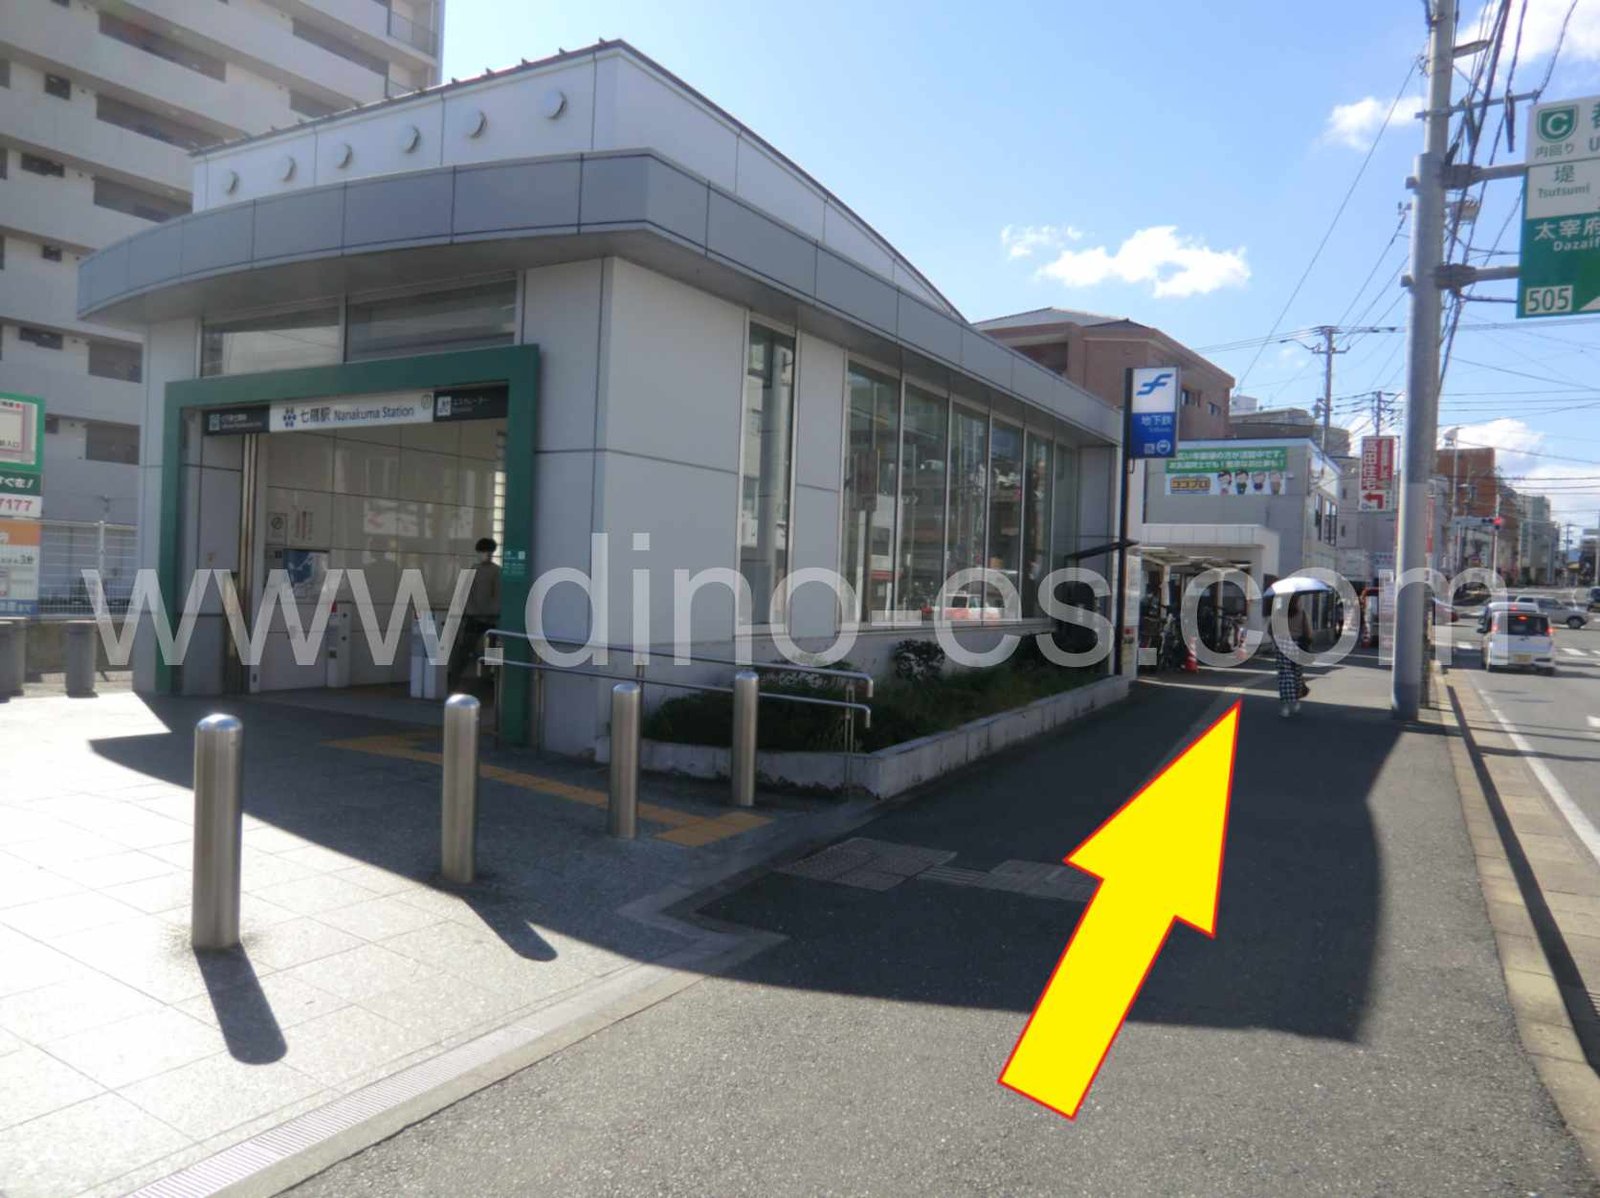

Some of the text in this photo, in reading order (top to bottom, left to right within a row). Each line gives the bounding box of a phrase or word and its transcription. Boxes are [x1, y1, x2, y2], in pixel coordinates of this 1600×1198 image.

[1546, 112, 1568, 136] C
[1535, 143, 1574, 159] 内回り
[1554, 164, 1575, 184] 堤
[1538, 182, 1591, 199] Tsutsumi
[1528, 288, 1570, 313] 505
[334, 406, 380, 422] Nanakuma
[383, 405, 414, 418] Station
[1141, 415, 1173, 427] 地下鉄
